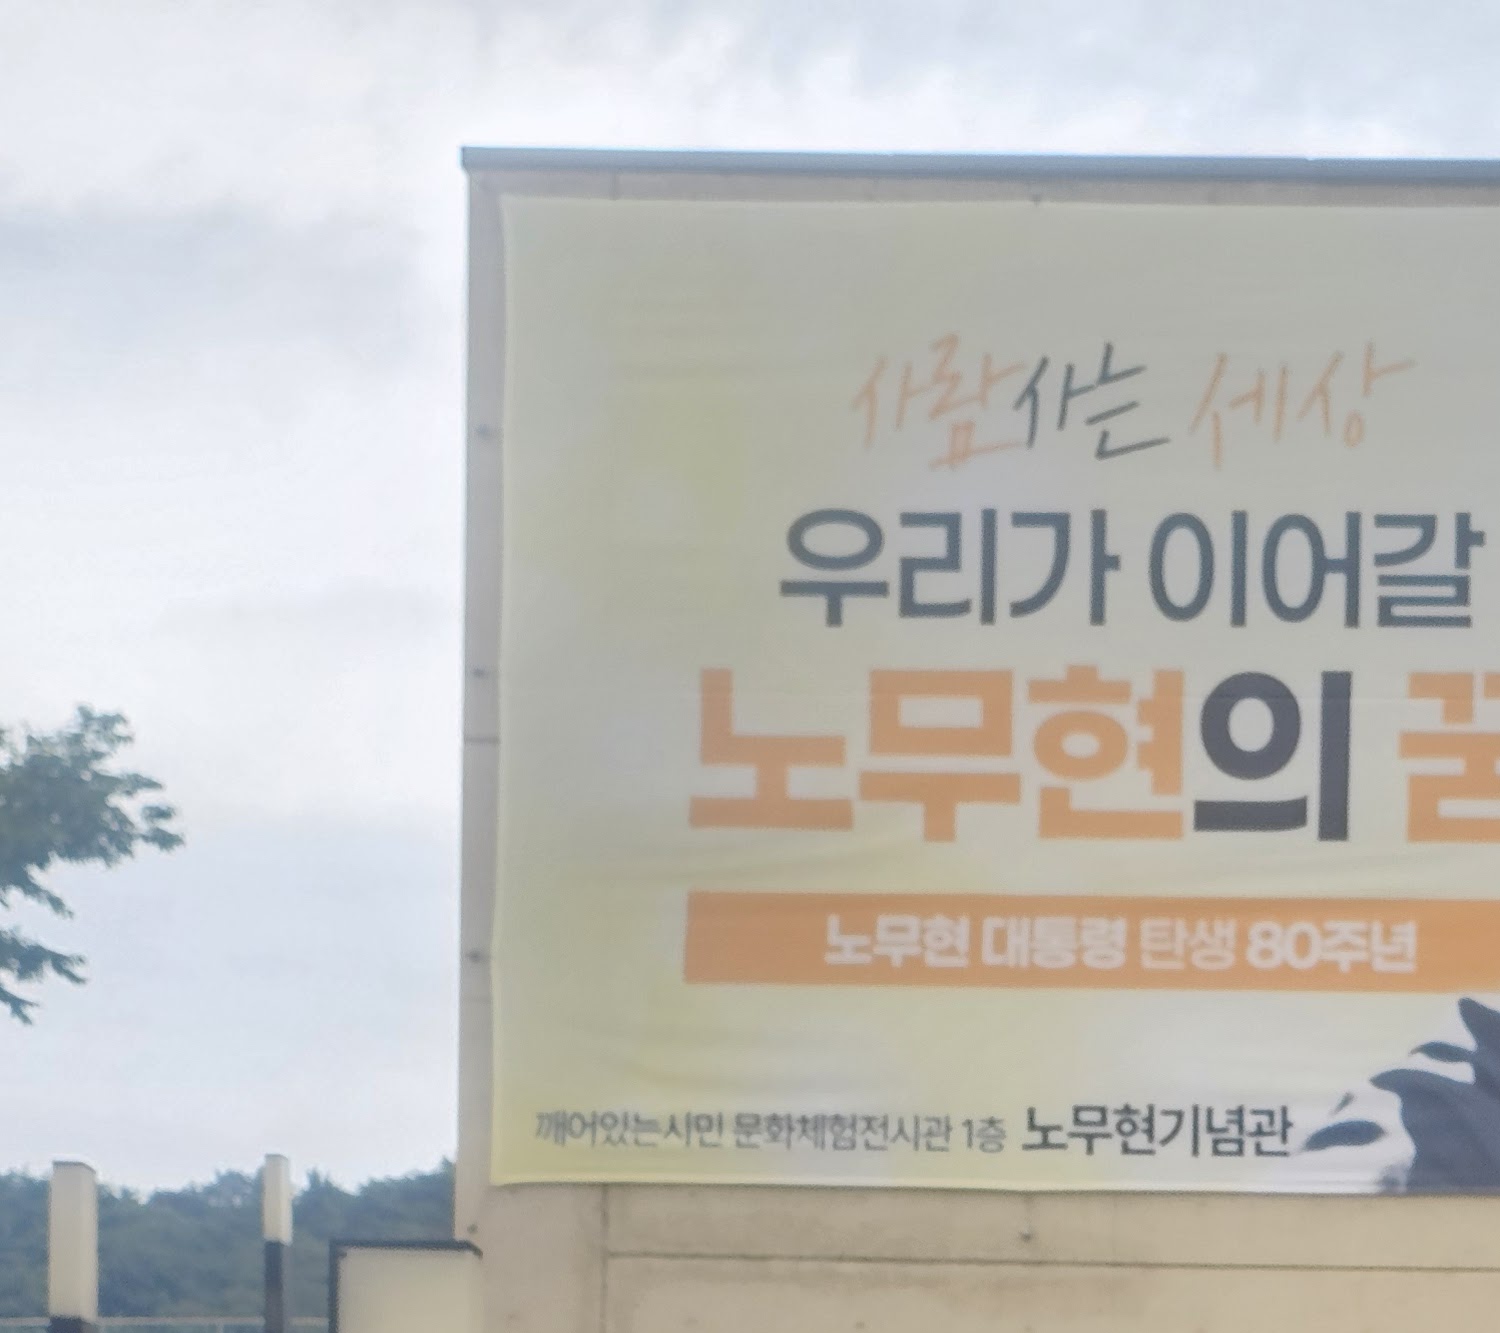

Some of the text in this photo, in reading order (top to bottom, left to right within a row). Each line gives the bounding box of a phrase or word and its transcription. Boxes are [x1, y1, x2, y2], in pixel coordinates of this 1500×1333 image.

[1188, 338, 1415, 470] 세상
[780, 507, 1486, 629] 우리가 이어갈
[688, 664, 1353, 843] 노무현의
[825, 912, 1417, 974] 노무현 대통령 탄생 80주년
[733, 1111, 953, 1152] 문화체험전시관
[962, 1115, 1006, 1154] 1층
[1021, 1103, 1293, 1158] 노무현기념관
